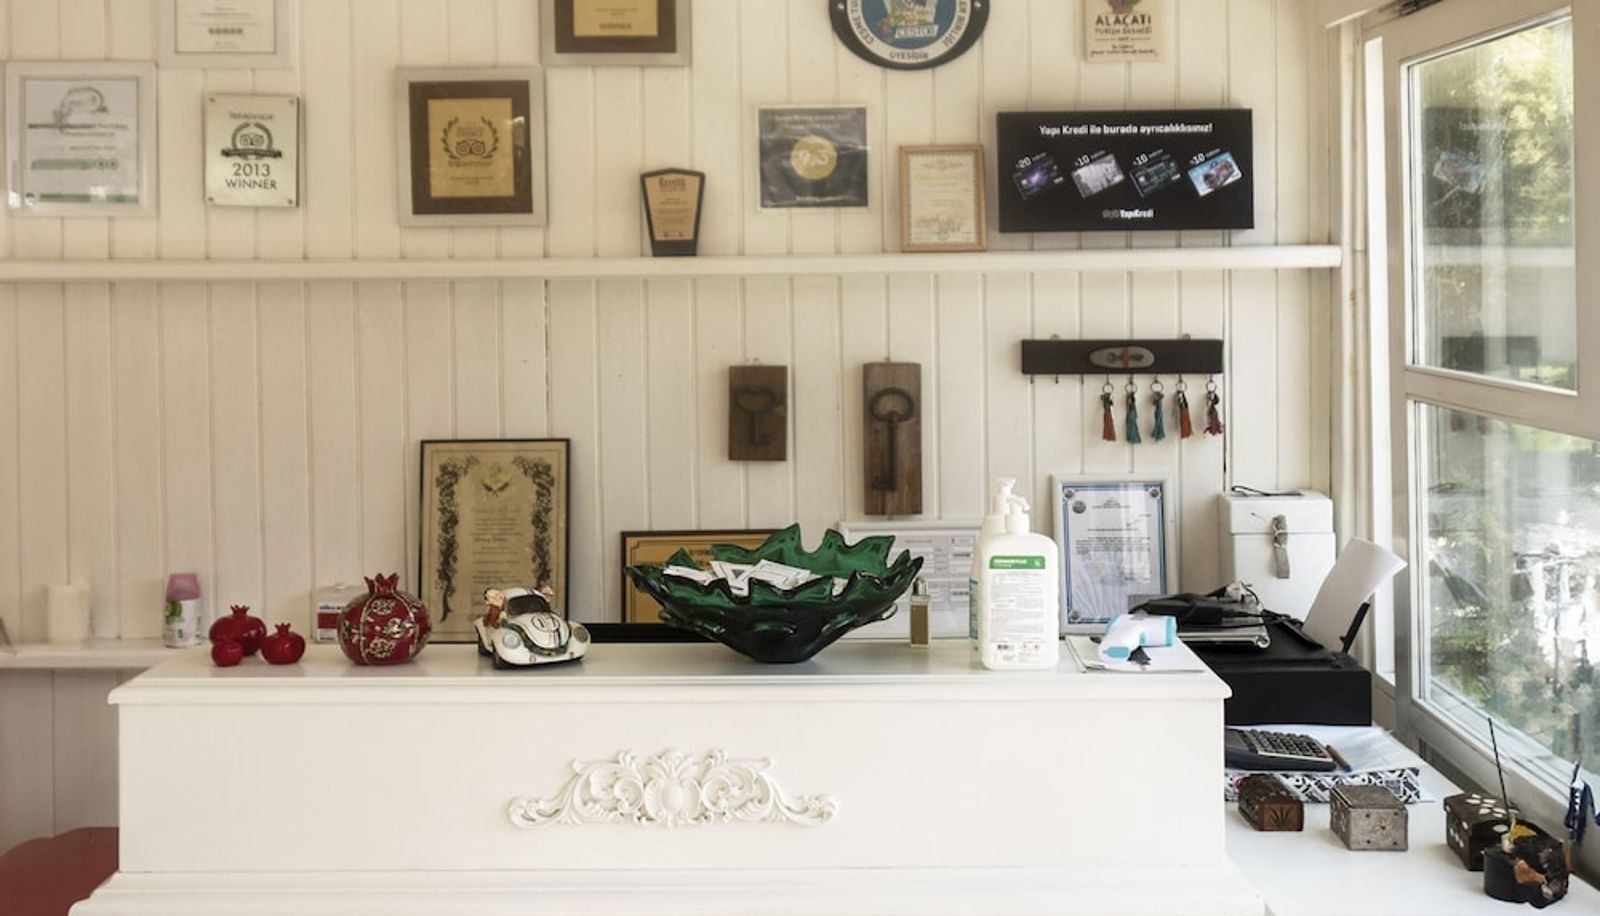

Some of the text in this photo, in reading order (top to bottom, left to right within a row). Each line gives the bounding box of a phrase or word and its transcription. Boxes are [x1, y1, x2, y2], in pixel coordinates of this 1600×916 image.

[1095, 14, 1152, 27] ALAÇATI
[1062, 124, 1088, 135] Kredi
[1103, 124, 1138, 134] burada
[232, 162, 270, 177] 2013
[225, 178, 277, 190] WINNER
